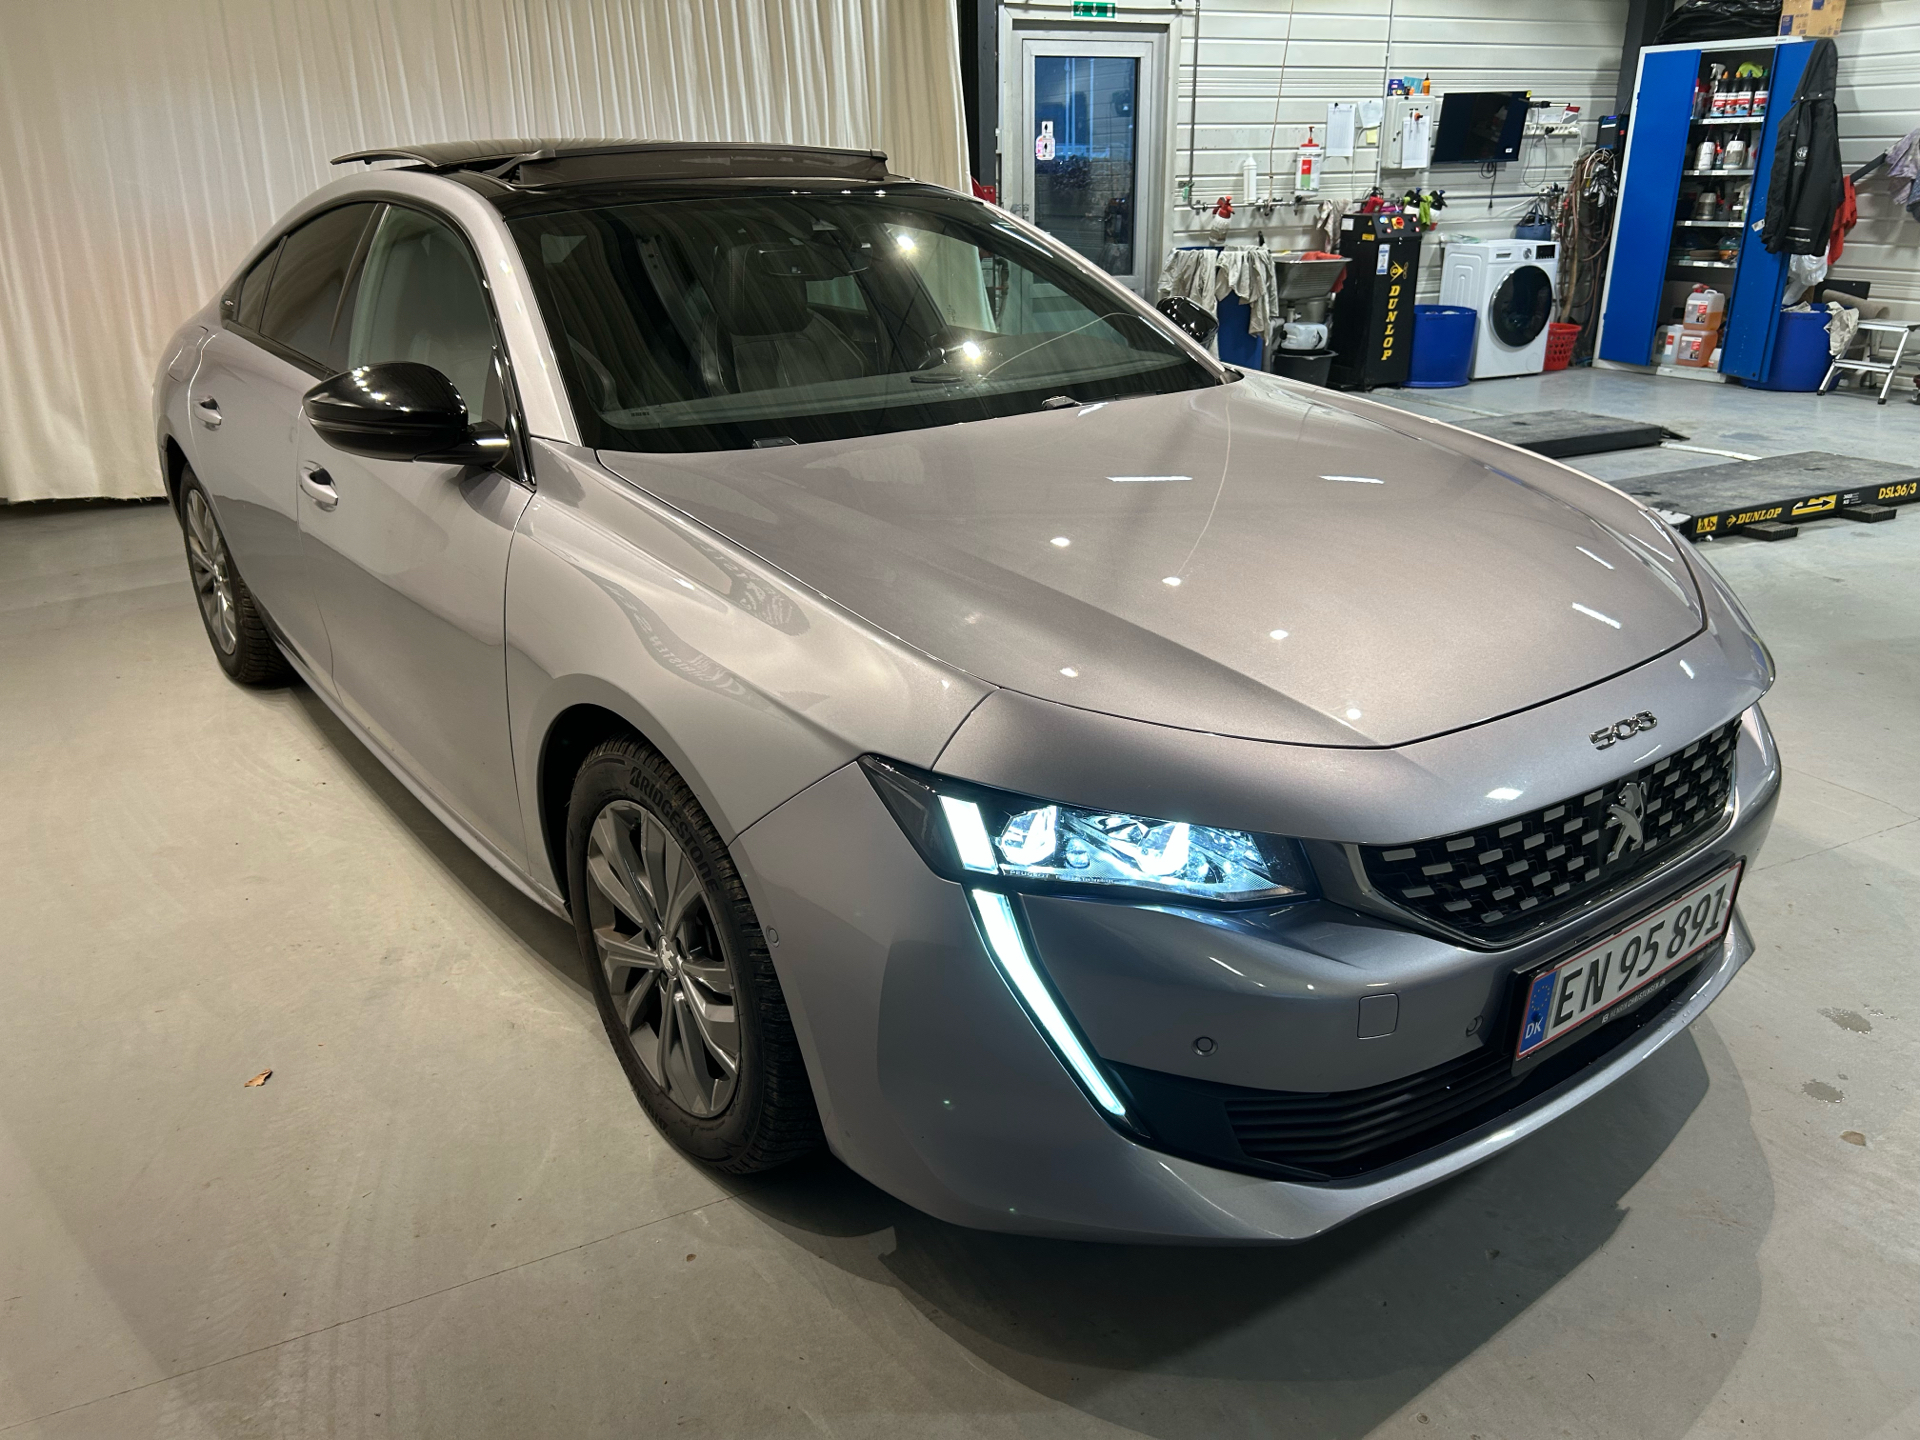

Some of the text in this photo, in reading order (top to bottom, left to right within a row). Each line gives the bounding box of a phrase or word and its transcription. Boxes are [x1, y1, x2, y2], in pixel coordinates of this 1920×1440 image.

[1381, 285, 1401, 361] DUNLOP
[1878, 483, 1917, 499] DSL36/3
[1736, 507, 1783, 525] DUNLOP
[1589, 709, 1657, 750] 508
[629, 766, 719, 894] BRIDGESTONE
[1552, 883, 1727, 1028] EN 95 891
[1525, 1016, 1544, 1039] DK
